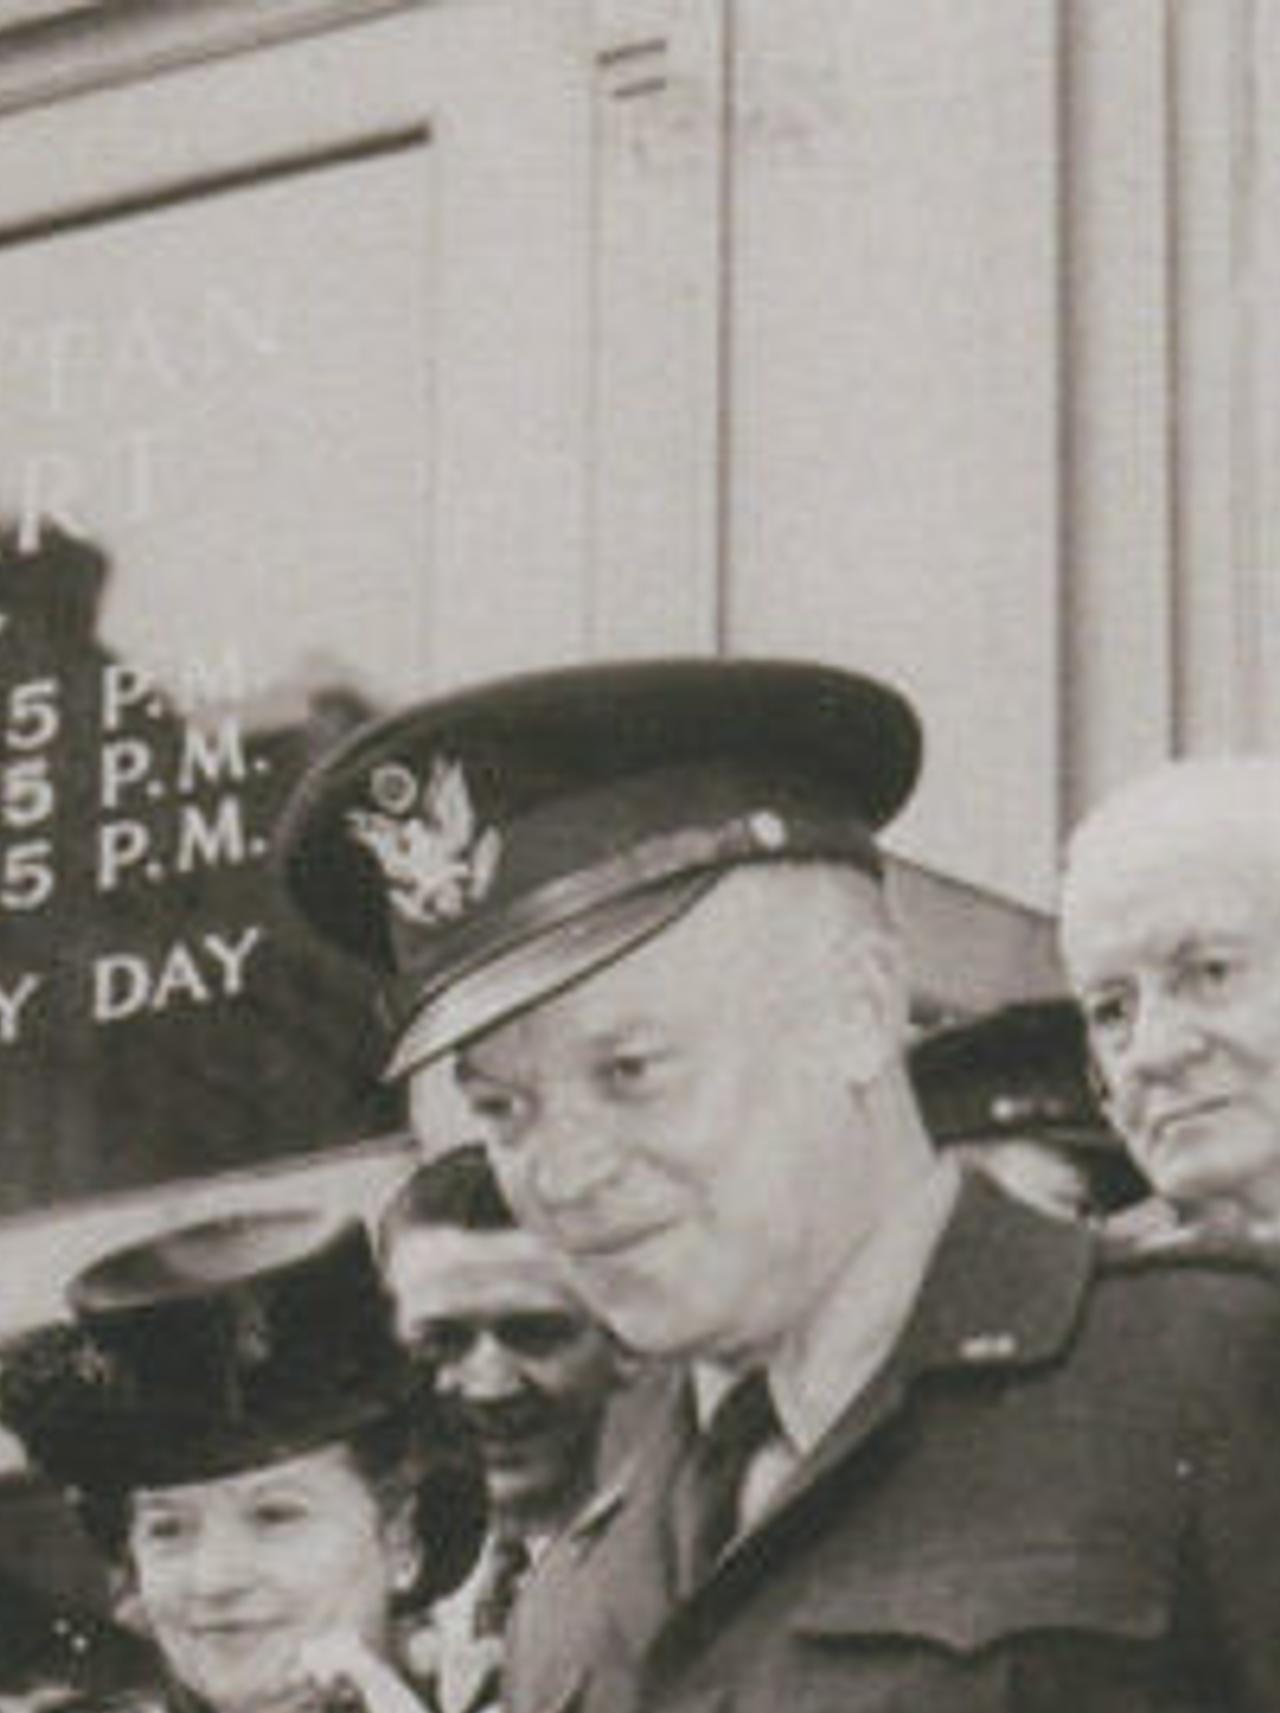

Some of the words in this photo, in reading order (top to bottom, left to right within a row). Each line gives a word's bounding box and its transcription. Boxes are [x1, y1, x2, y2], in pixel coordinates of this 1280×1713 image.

[100, 716, 271, 808] P.M.
[96, 796, 268, 891] P.M.
[93, 927, 260, 1020] DAY
